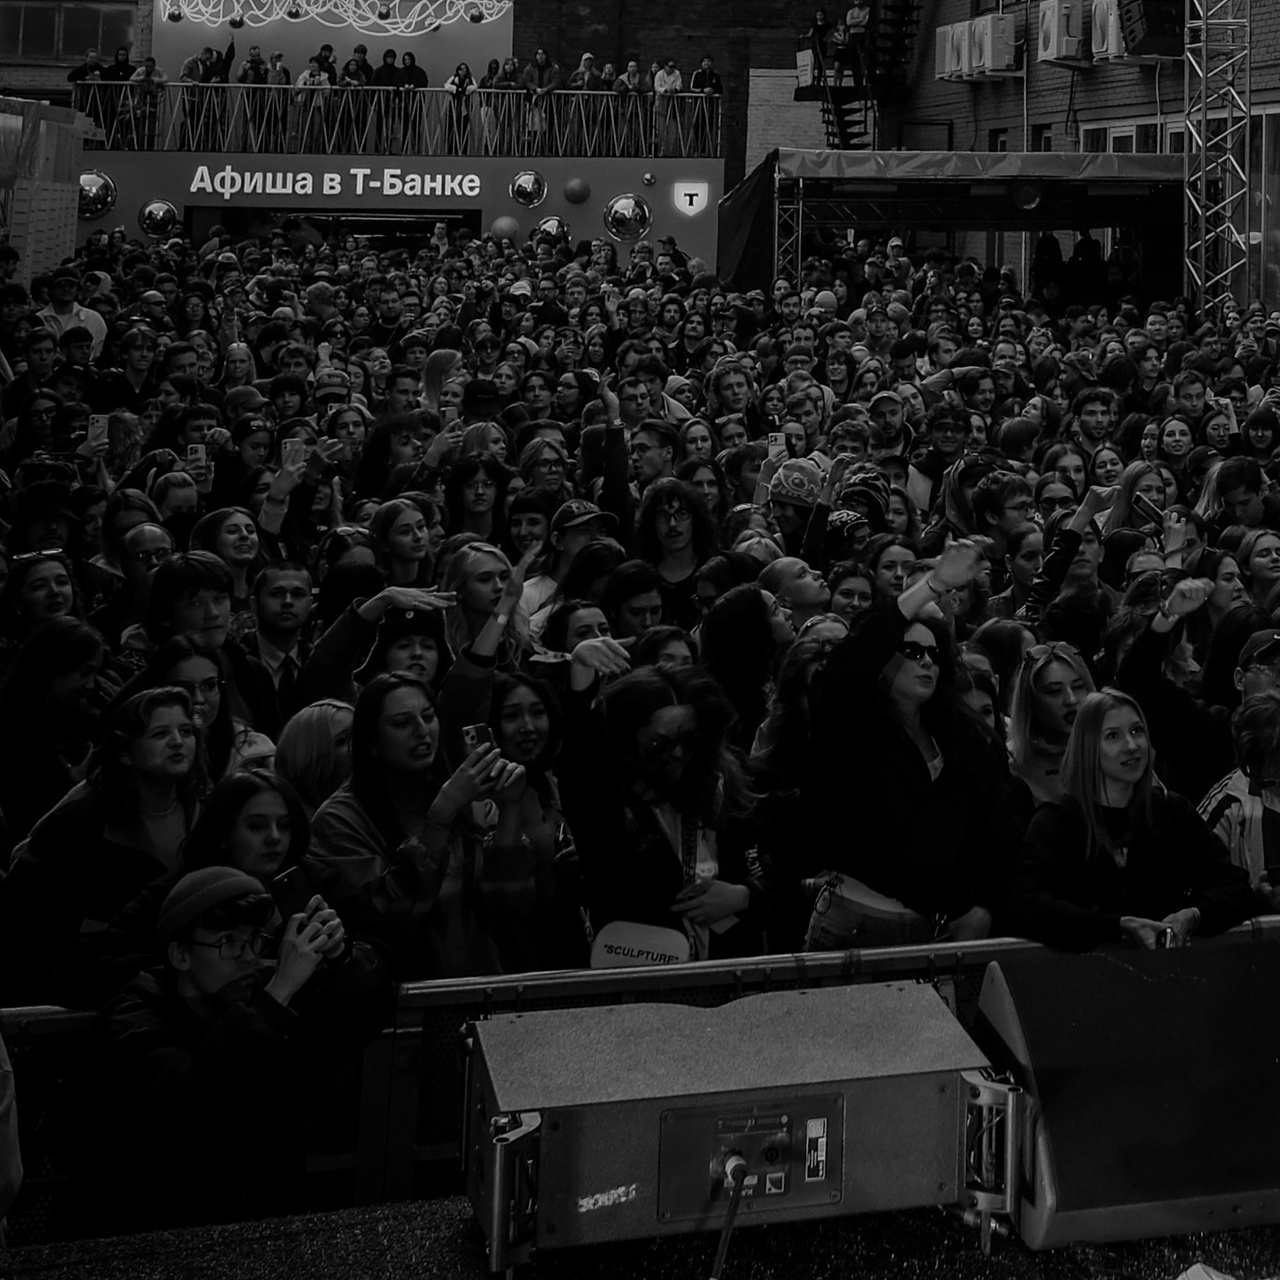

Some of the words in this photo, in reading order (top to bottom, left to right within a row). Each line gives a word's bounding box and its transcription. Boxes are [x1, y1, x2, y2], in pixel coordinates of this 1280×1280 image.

[189, 165, 313, 200] Афиша
[323, 173, 341, 195] в
[350, 168, 480, 196] Т-Банке
